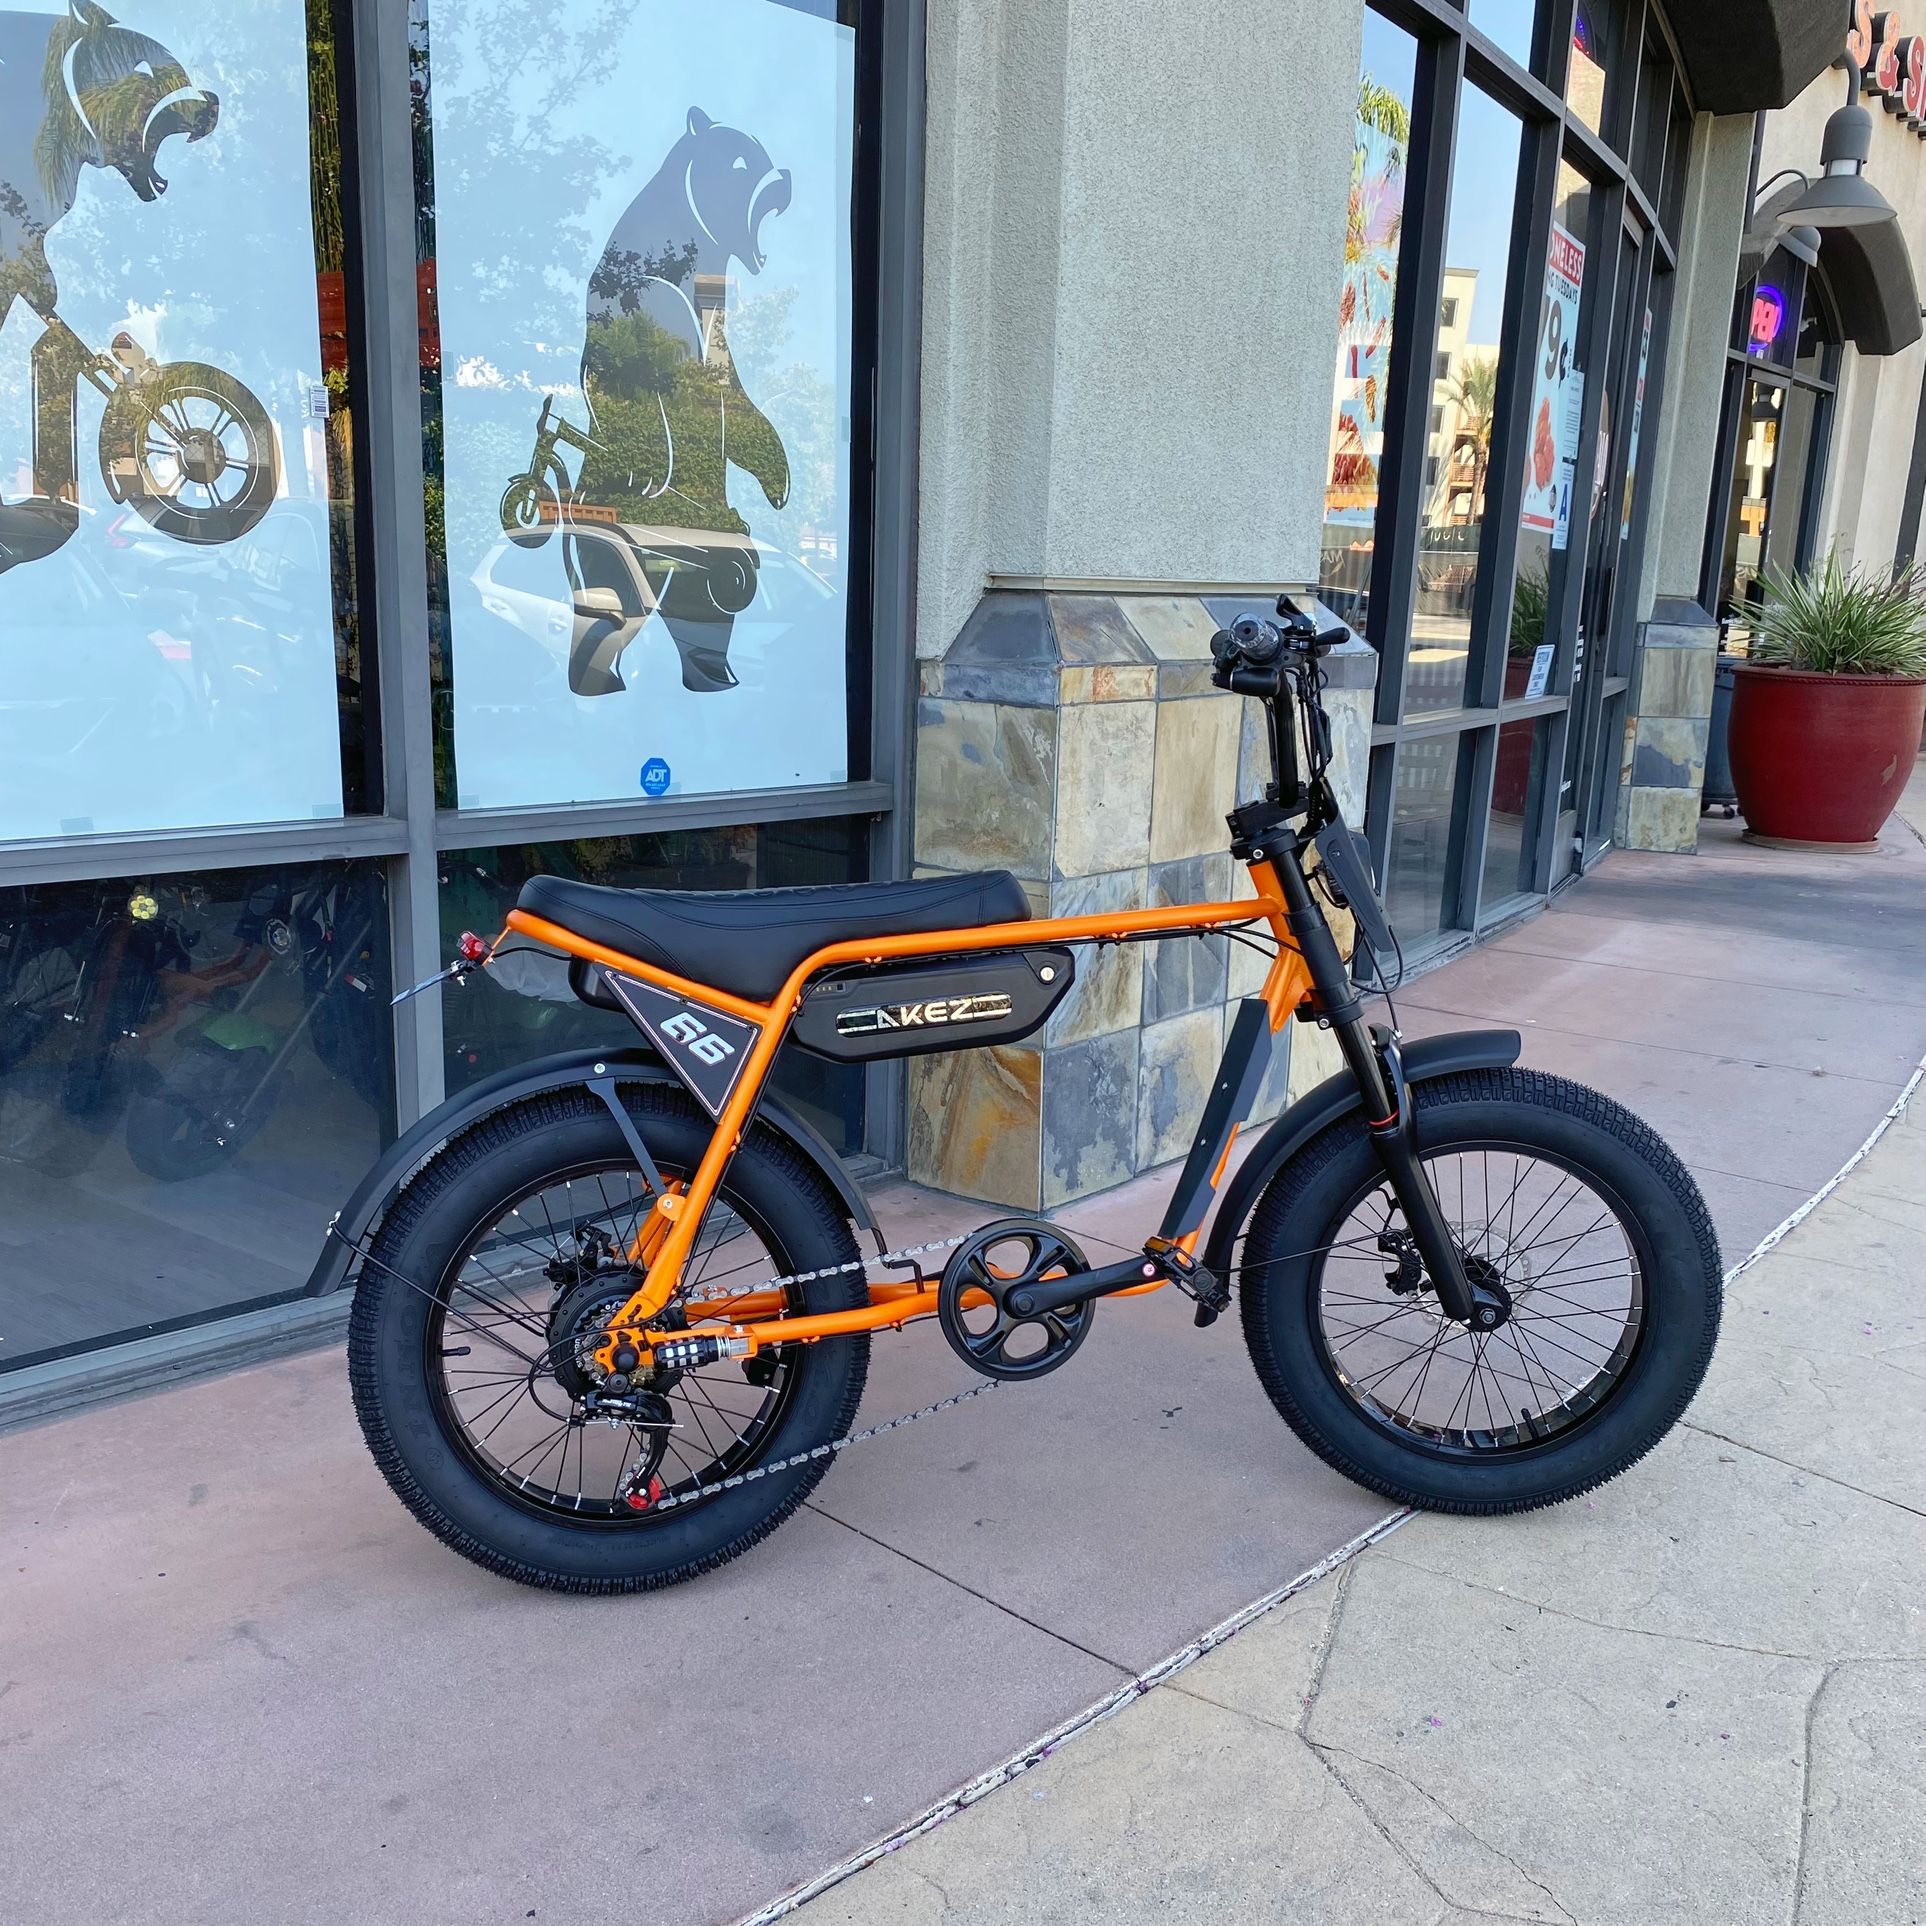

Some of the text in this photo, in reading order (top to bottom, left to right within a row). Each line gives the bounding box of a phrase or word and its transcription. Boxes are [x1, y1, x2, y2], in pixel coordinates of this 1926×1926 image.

[1903, 36, 1926, 122] S
[1559, 484, 1568, 522] A
[645, 768, 667, 782] ADT
